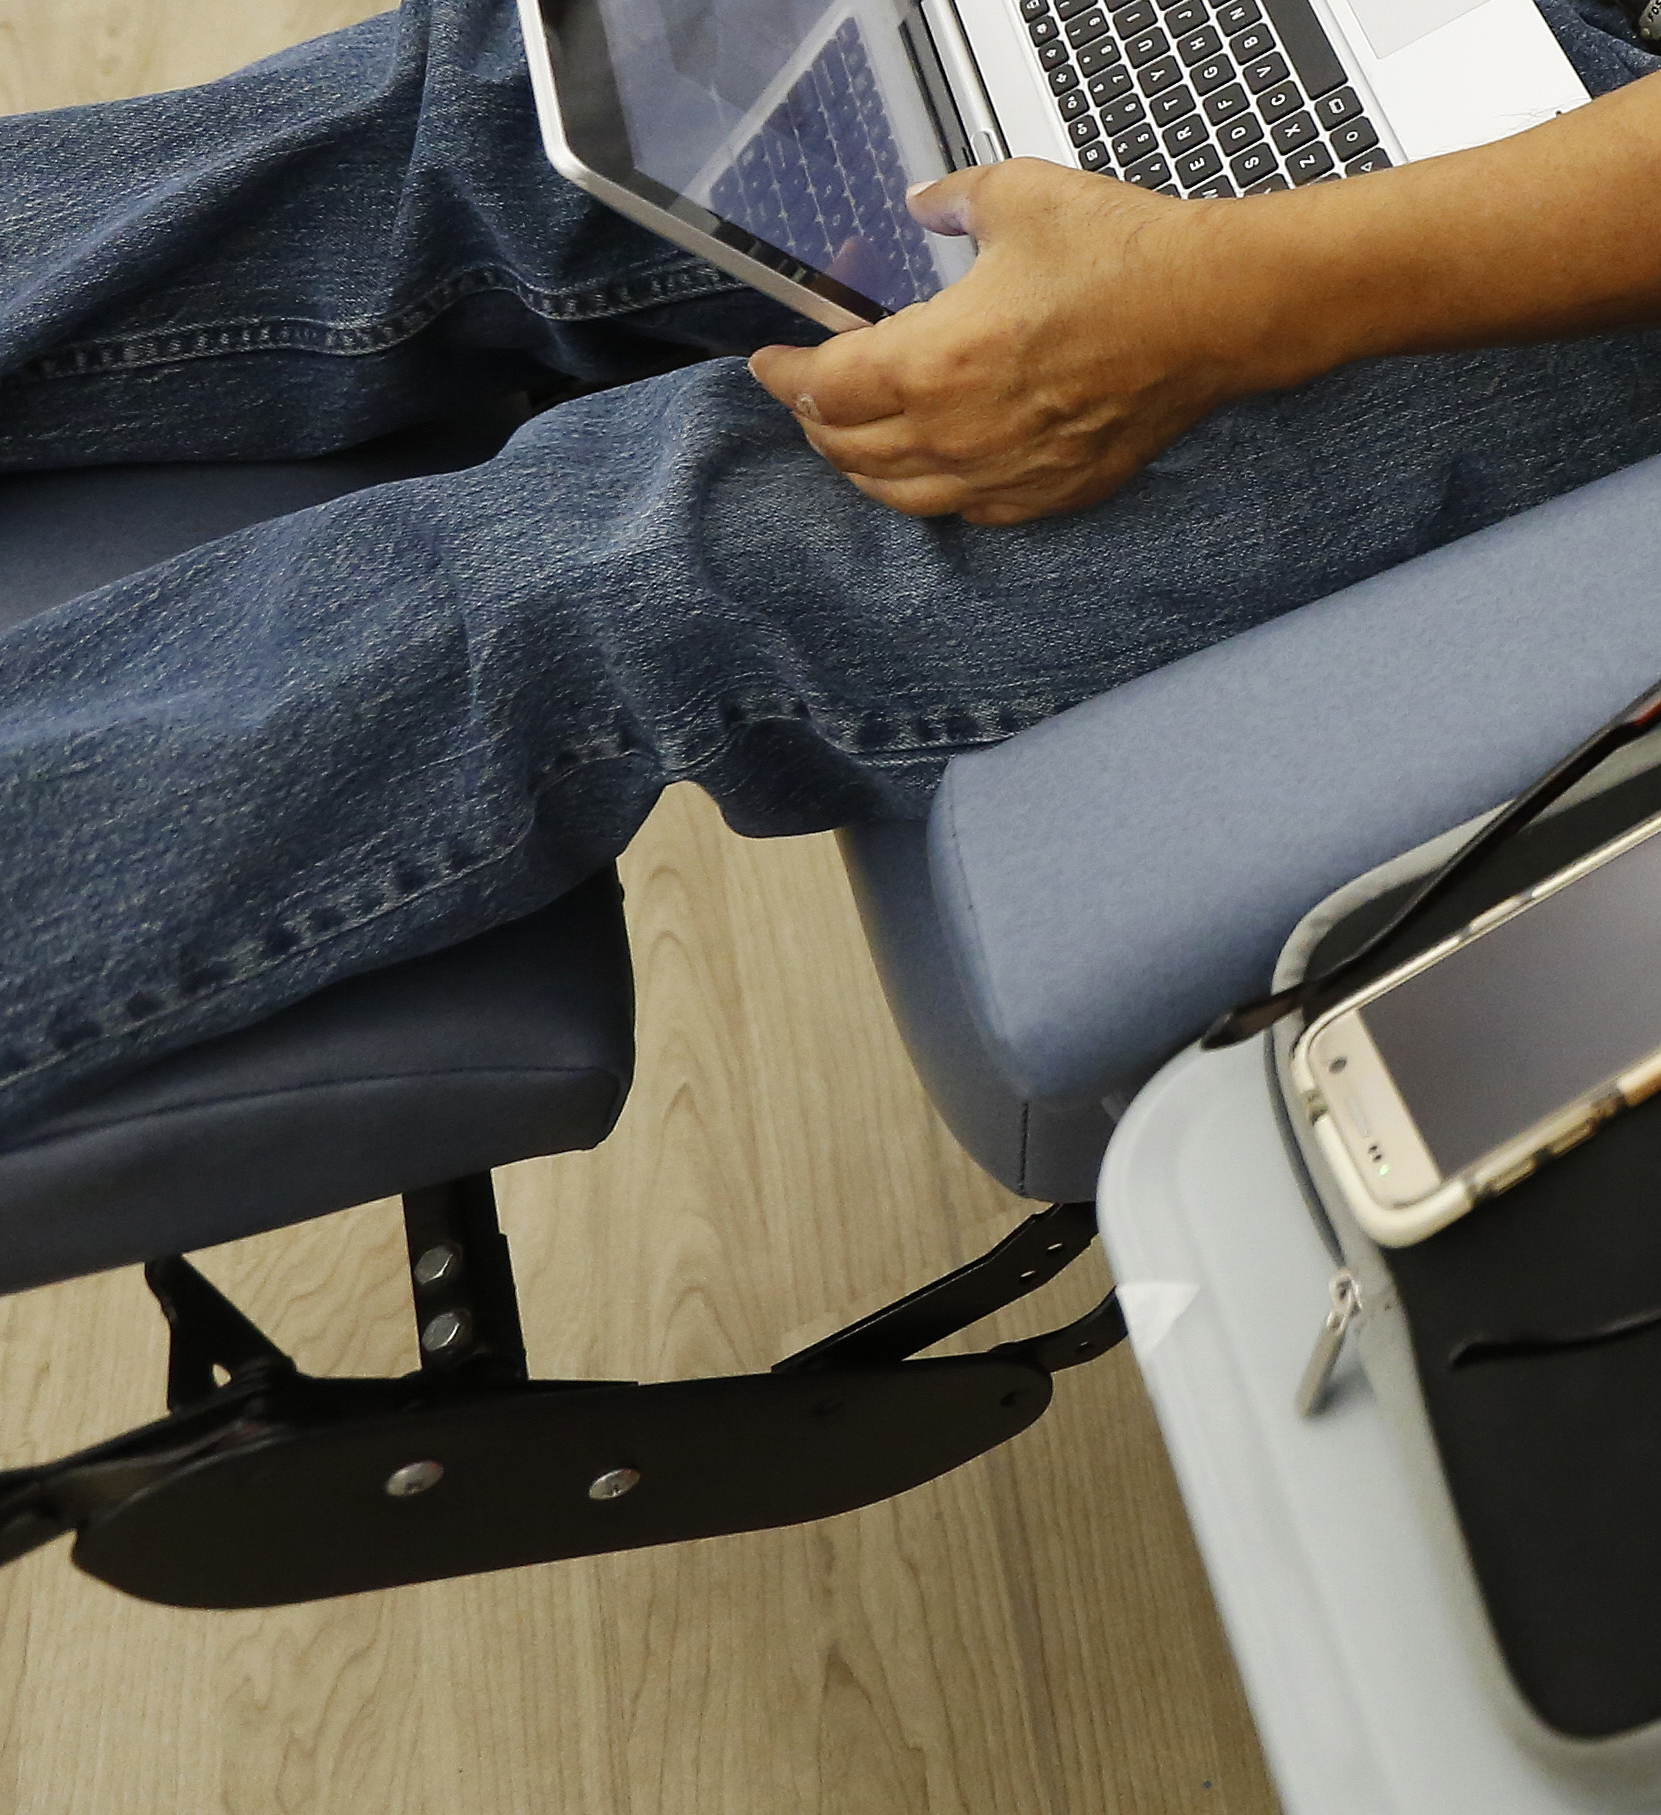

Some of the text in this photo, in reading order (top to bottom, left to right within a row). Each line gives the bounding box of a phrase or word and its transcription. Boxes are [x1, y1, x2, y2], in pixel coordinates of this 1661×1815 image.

[1088, 16, 1102, 27] 9
[1176, 9, 1193, 20] J
[1228, 6, 1246, 22] N
[1099, 44, 1113, 56] 8
[1136, 38, 1154, 53] U
[1188, 35, 1207, 52] H
[1242, 35, 1259, 50] B
[1111, 74, 1126, 85] 7
[1149, 68, 1166, 83] Y
[1202, 65, 1219, 80] G
[1255, 65, 1273, 79] V
[1123, 101, 1138, 113] 6
[1162, 98, 1180, 112] T
[1216, 99, 1234, 111] F
[1270, 92, 1287, 107] C
[1136, 132, 1150, 144] 5
[1175, 125, 1193, 142] R
[1230, 125, 1247, 141] D
[1283, 122, 1302, 139] X
[1149, 162, 1162, 172] 4
[1188, 156, 1206, 172] E
[1243, 155, 1261, 170] S
[1298, 153, 1317, 170] Z
